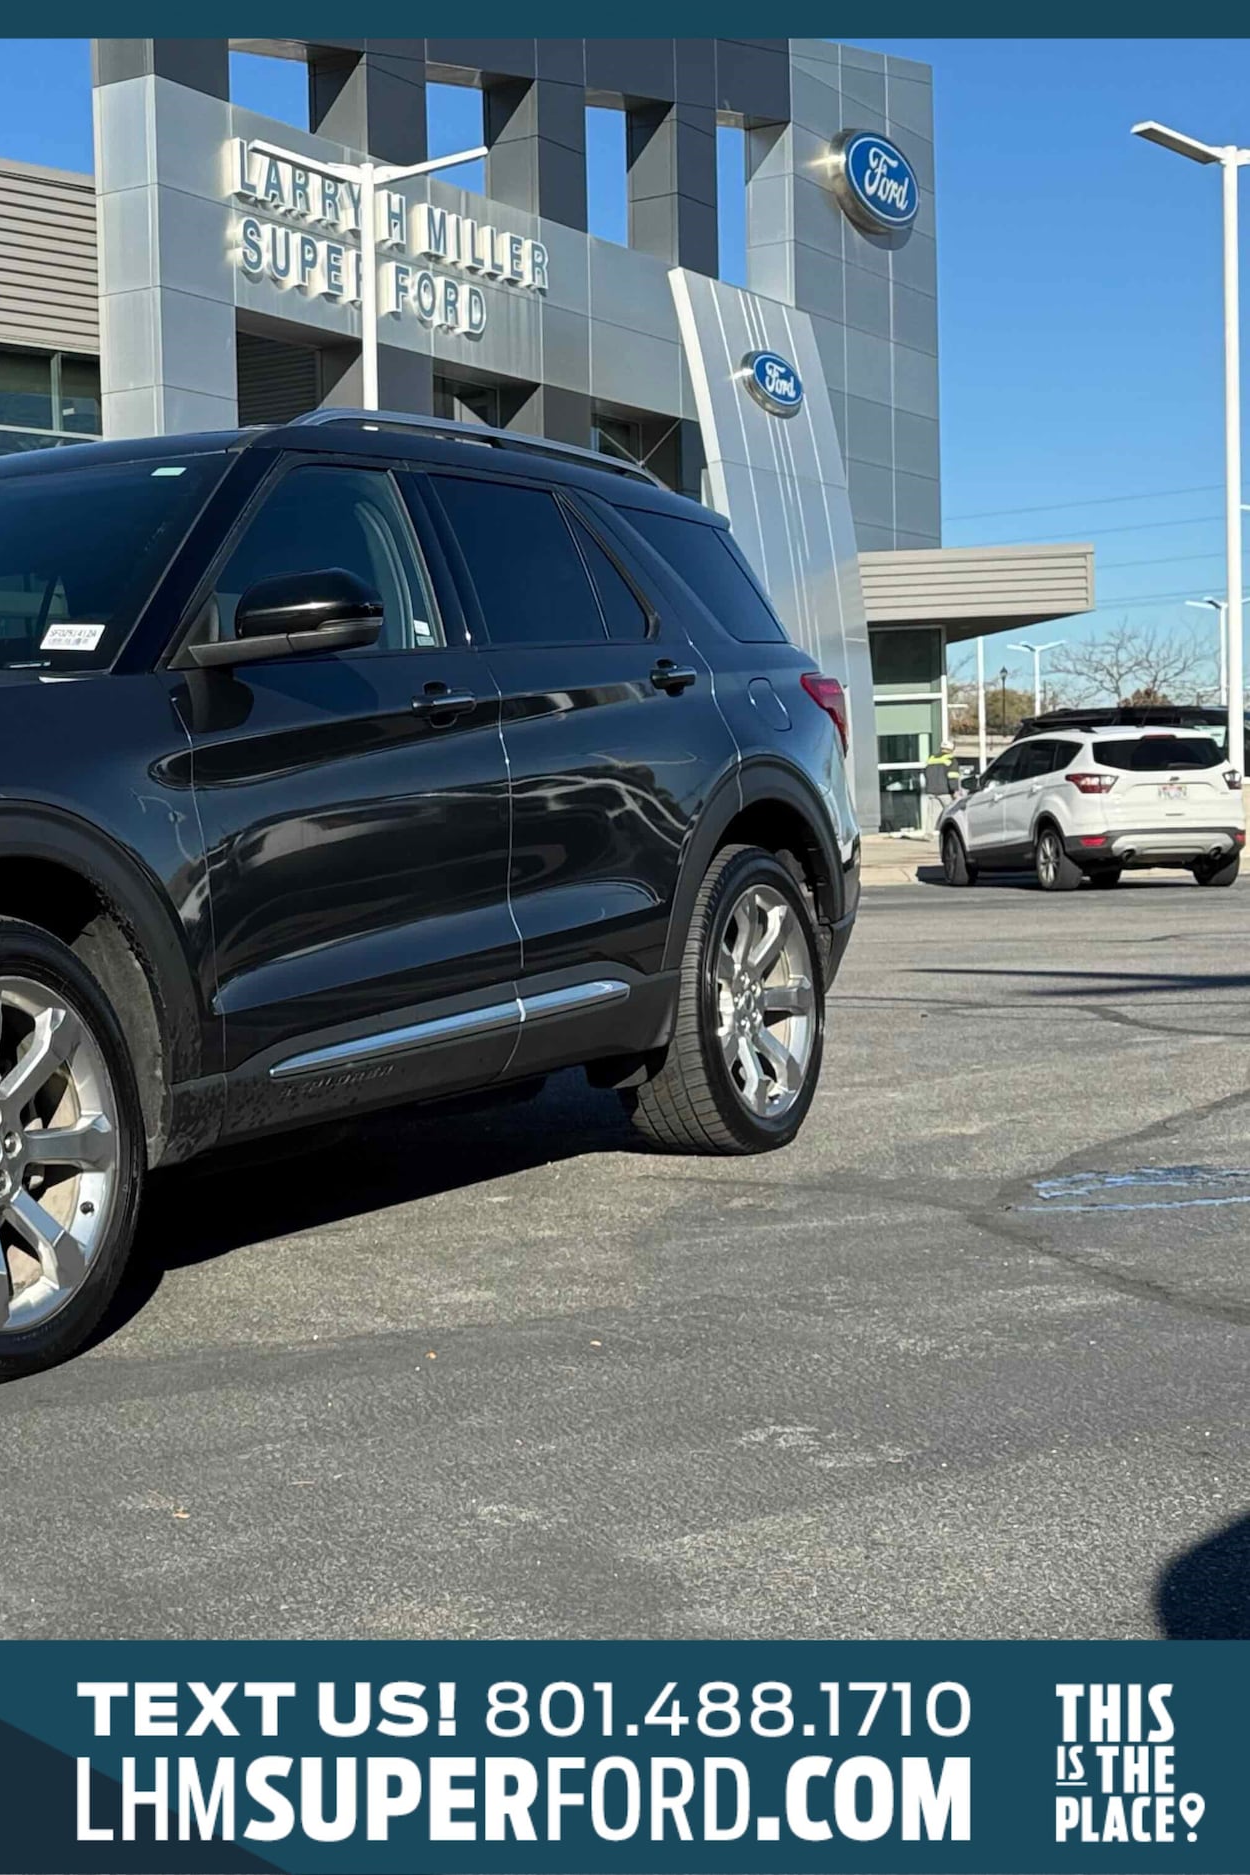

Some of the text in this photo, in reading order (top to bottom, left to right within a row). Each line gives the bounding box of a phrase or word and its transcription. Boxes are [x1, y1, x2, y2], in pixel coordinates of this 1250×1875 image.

[864, 147, 909, 211] Ford
[377, 190, 406, 246] H
[417, 203, 549, 290] MILLER
[384, 261, 487, 334] FORD
[765, 361, 797, 398] Ford
